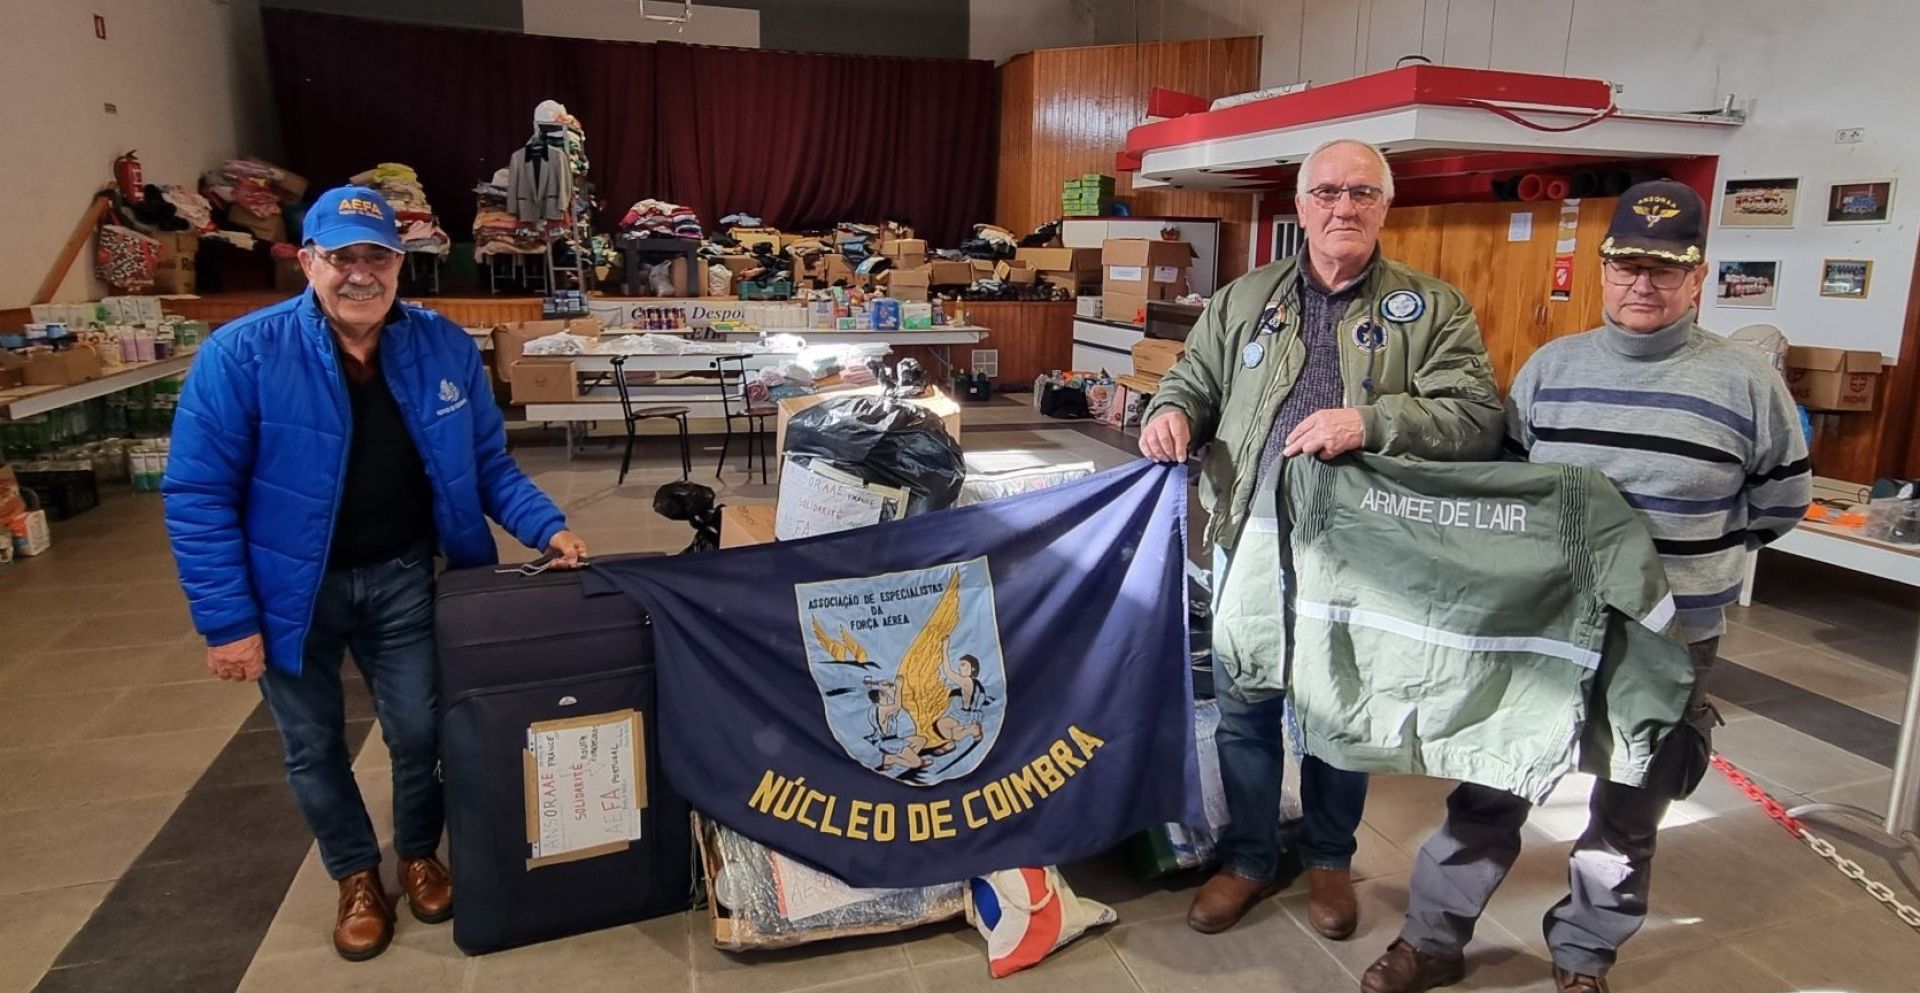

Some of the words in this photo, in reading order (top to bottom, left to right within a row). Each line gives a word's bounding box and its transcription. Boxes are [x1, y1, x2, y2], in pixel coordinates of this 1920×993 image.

[339, 199, 384, 216] AEFA
[1360, 487, 1434, 524] ARMEE
[1438, 500, 1471, 527] DE
[1475, 502, 1528, 532] L'AIR
[808, 595, 860, 610] ASSOCIAÇÃO
[863, 593, 875, 604] DE
[880, 583, 944, 602] ESPECIALISTAS
[871, 606, 884, 616] DA
[850, 620, 879, 631] FORÇA
[546, 735, 557, 767] FRANCE
[610, 743, 620, 785] PORTUGAL
[570, 762, 587, 822] SOLIDARITÉ
[748, 769, 896, 842] NÚCLEO
[907, 799, 957, 842] DE
[962, 724, 1105, 830] COIMBRA
[600, 787, 623, 834] AEFA
